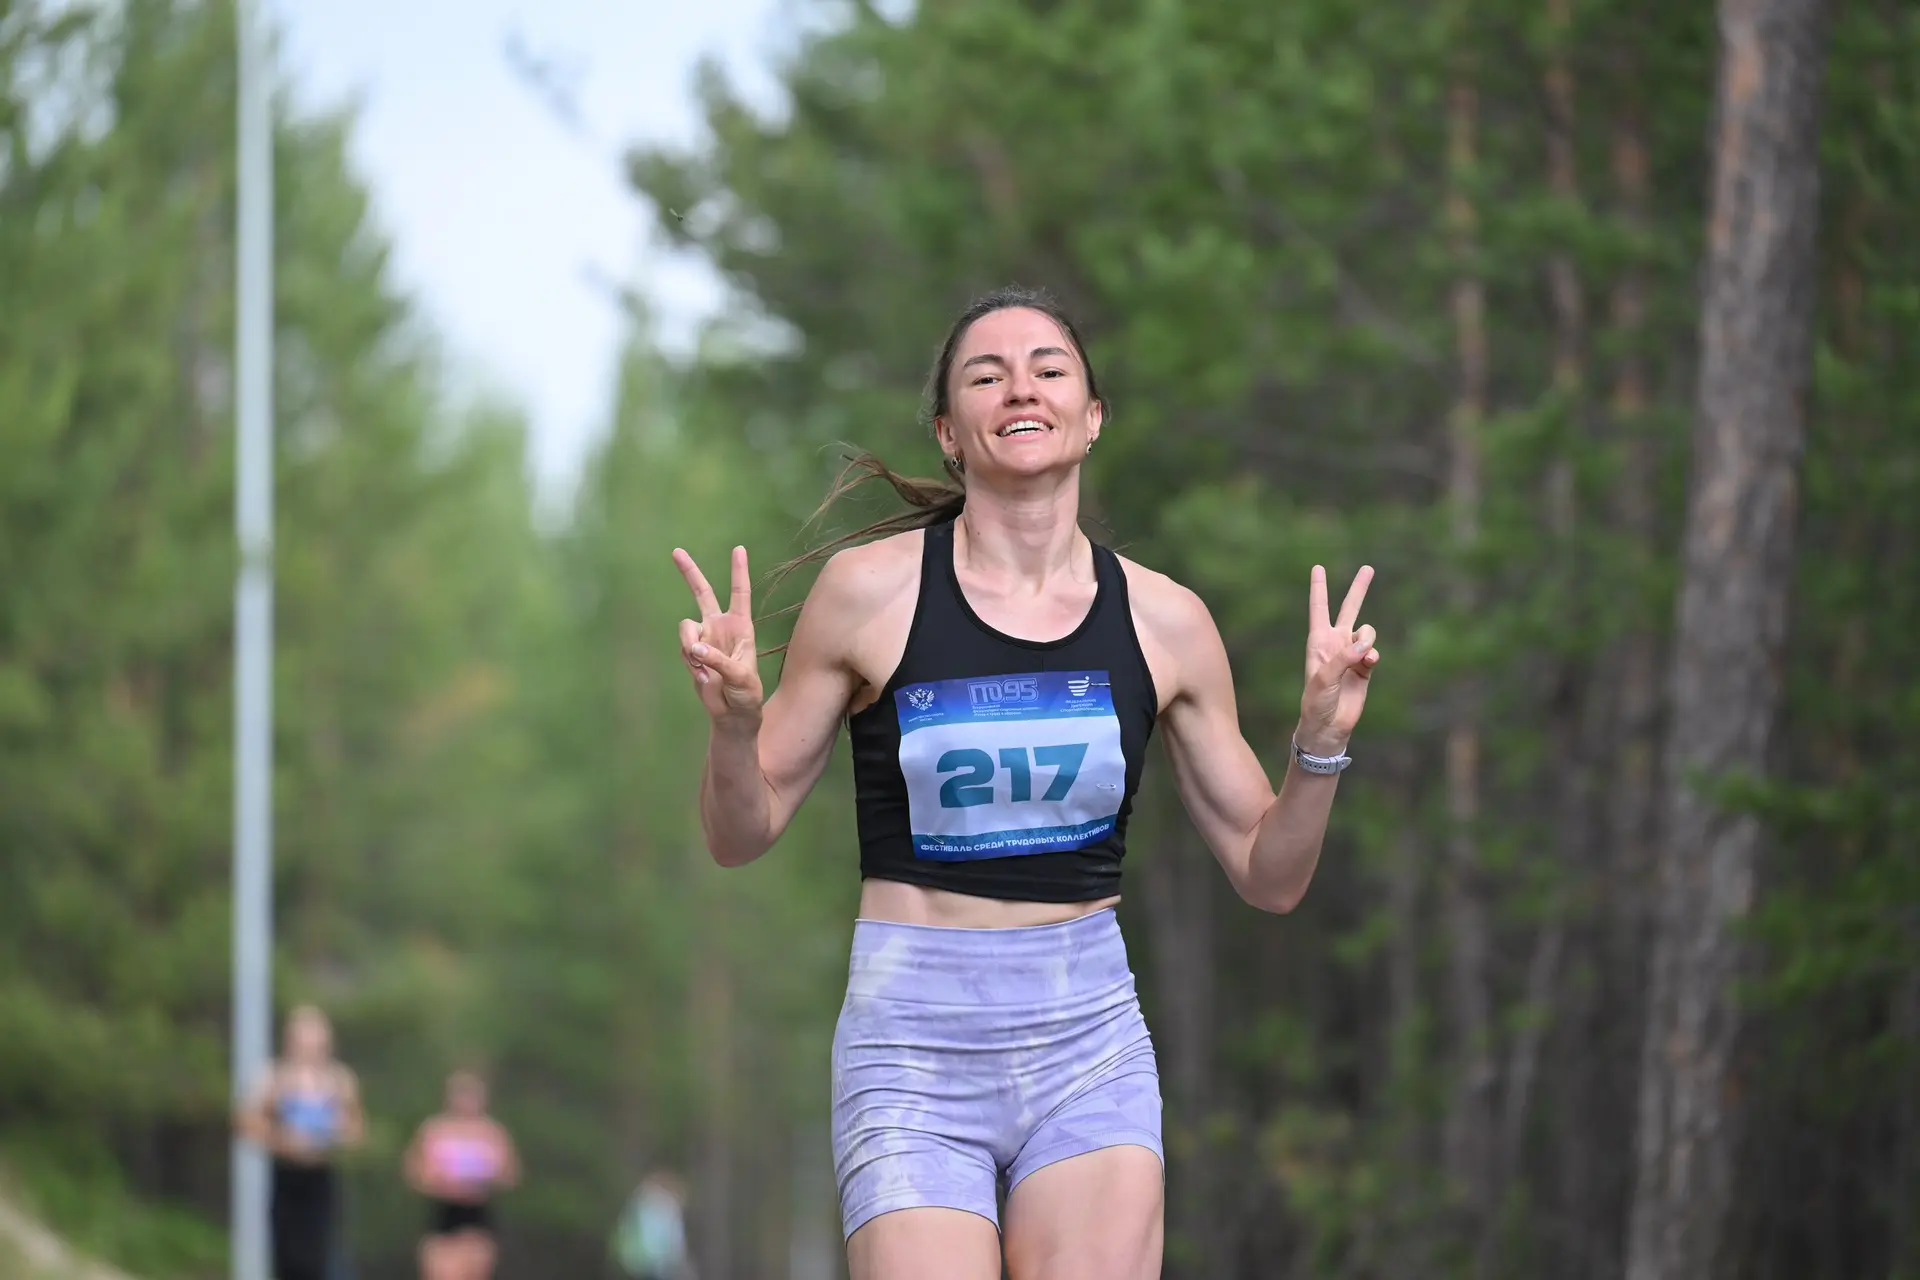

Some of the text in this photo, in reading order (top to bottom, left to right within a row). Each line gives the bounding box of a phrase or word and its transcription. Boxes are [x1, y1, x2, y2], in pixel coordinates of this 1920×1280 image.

[937, 743, 1090, 809] 217
[920, 823, 1110, 853] ФЕСТИВАЛЬ СРЕДИ ТРУДОВЫХ КОЛЛЕКТИВОВ
